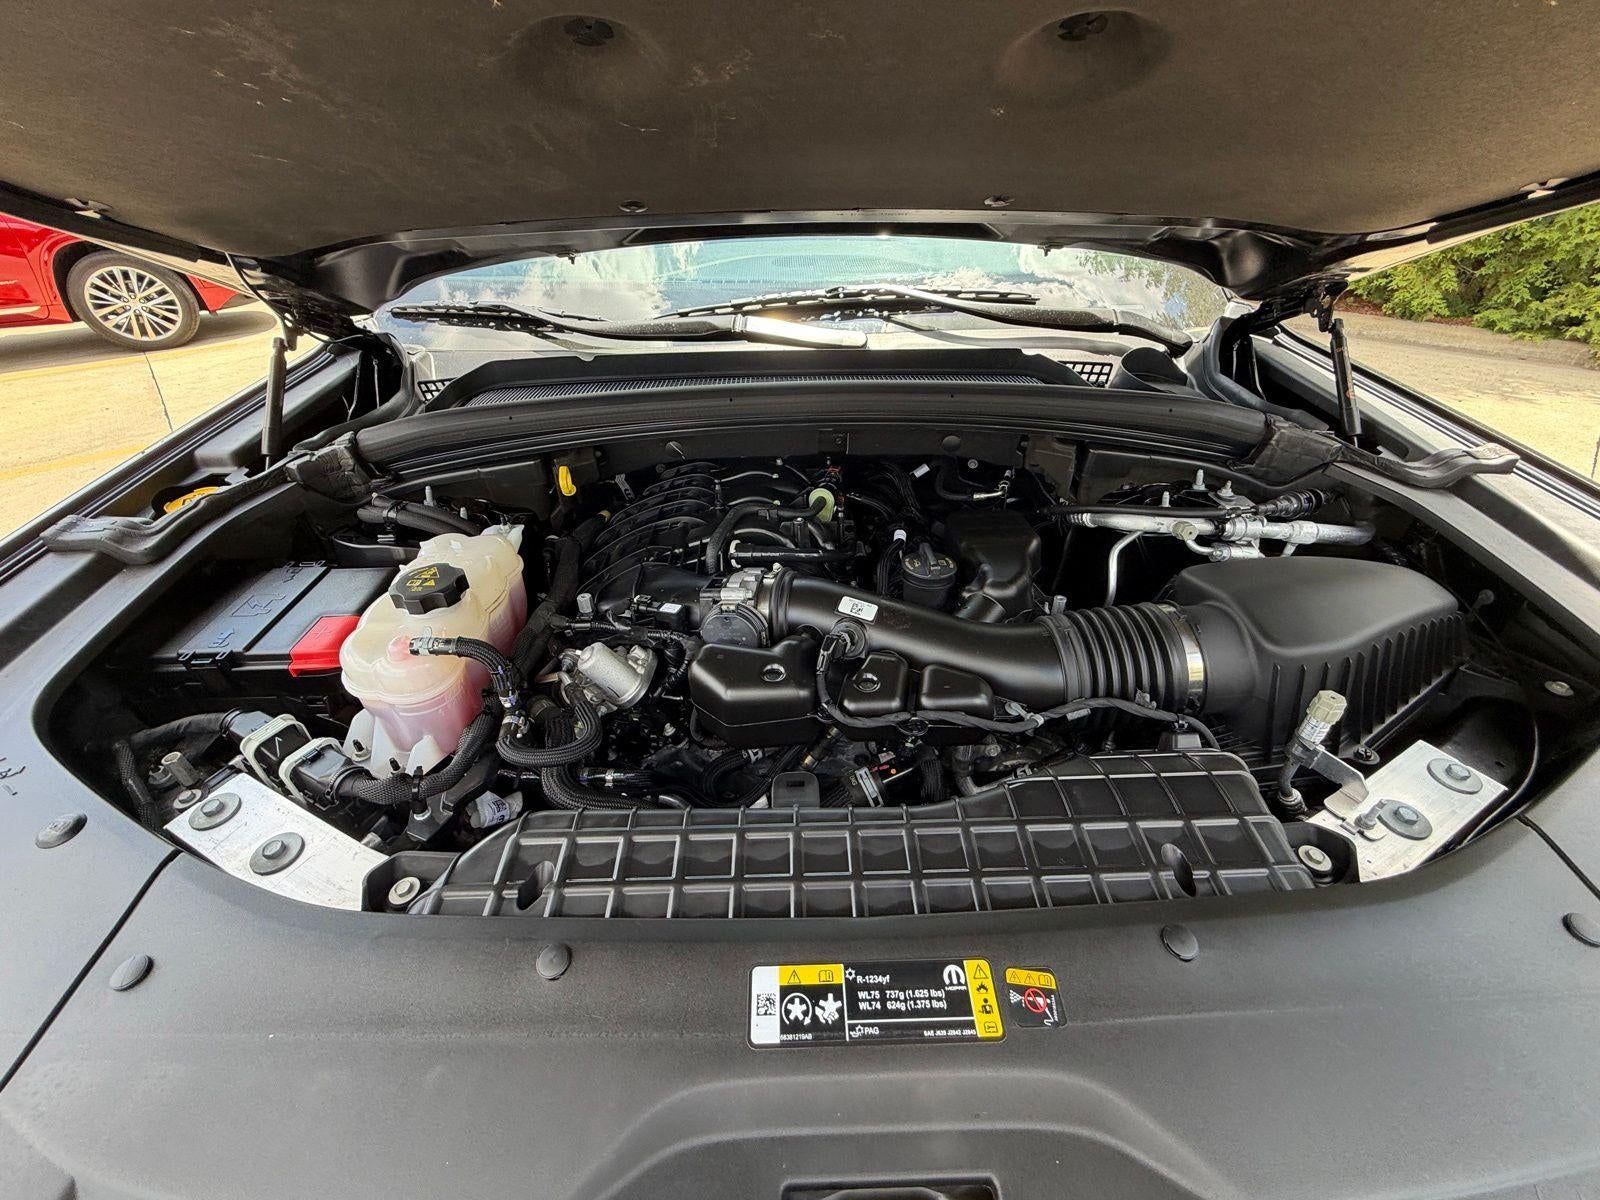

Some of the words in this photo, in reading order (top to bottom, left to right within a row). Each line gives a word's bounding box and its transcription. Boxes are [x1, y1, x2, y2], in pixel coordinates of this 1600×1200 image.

[856, 974, 890, 985] R-1234yf
[858, 990, 880, 1000] WL75
[885, 990, 904, 1000] 737g
[906, 989, 929, 999] (1.625
[930, 988, 946, 999] lbs)
[859, 1001, 881, 1010] WL74
[886, 1001, 906, 1011] 624g
[907, 1000, 930, 1010] (1.375
[931, 999, 947, 1010] lbs)
[864, 1026, 880, 1035] PAG
